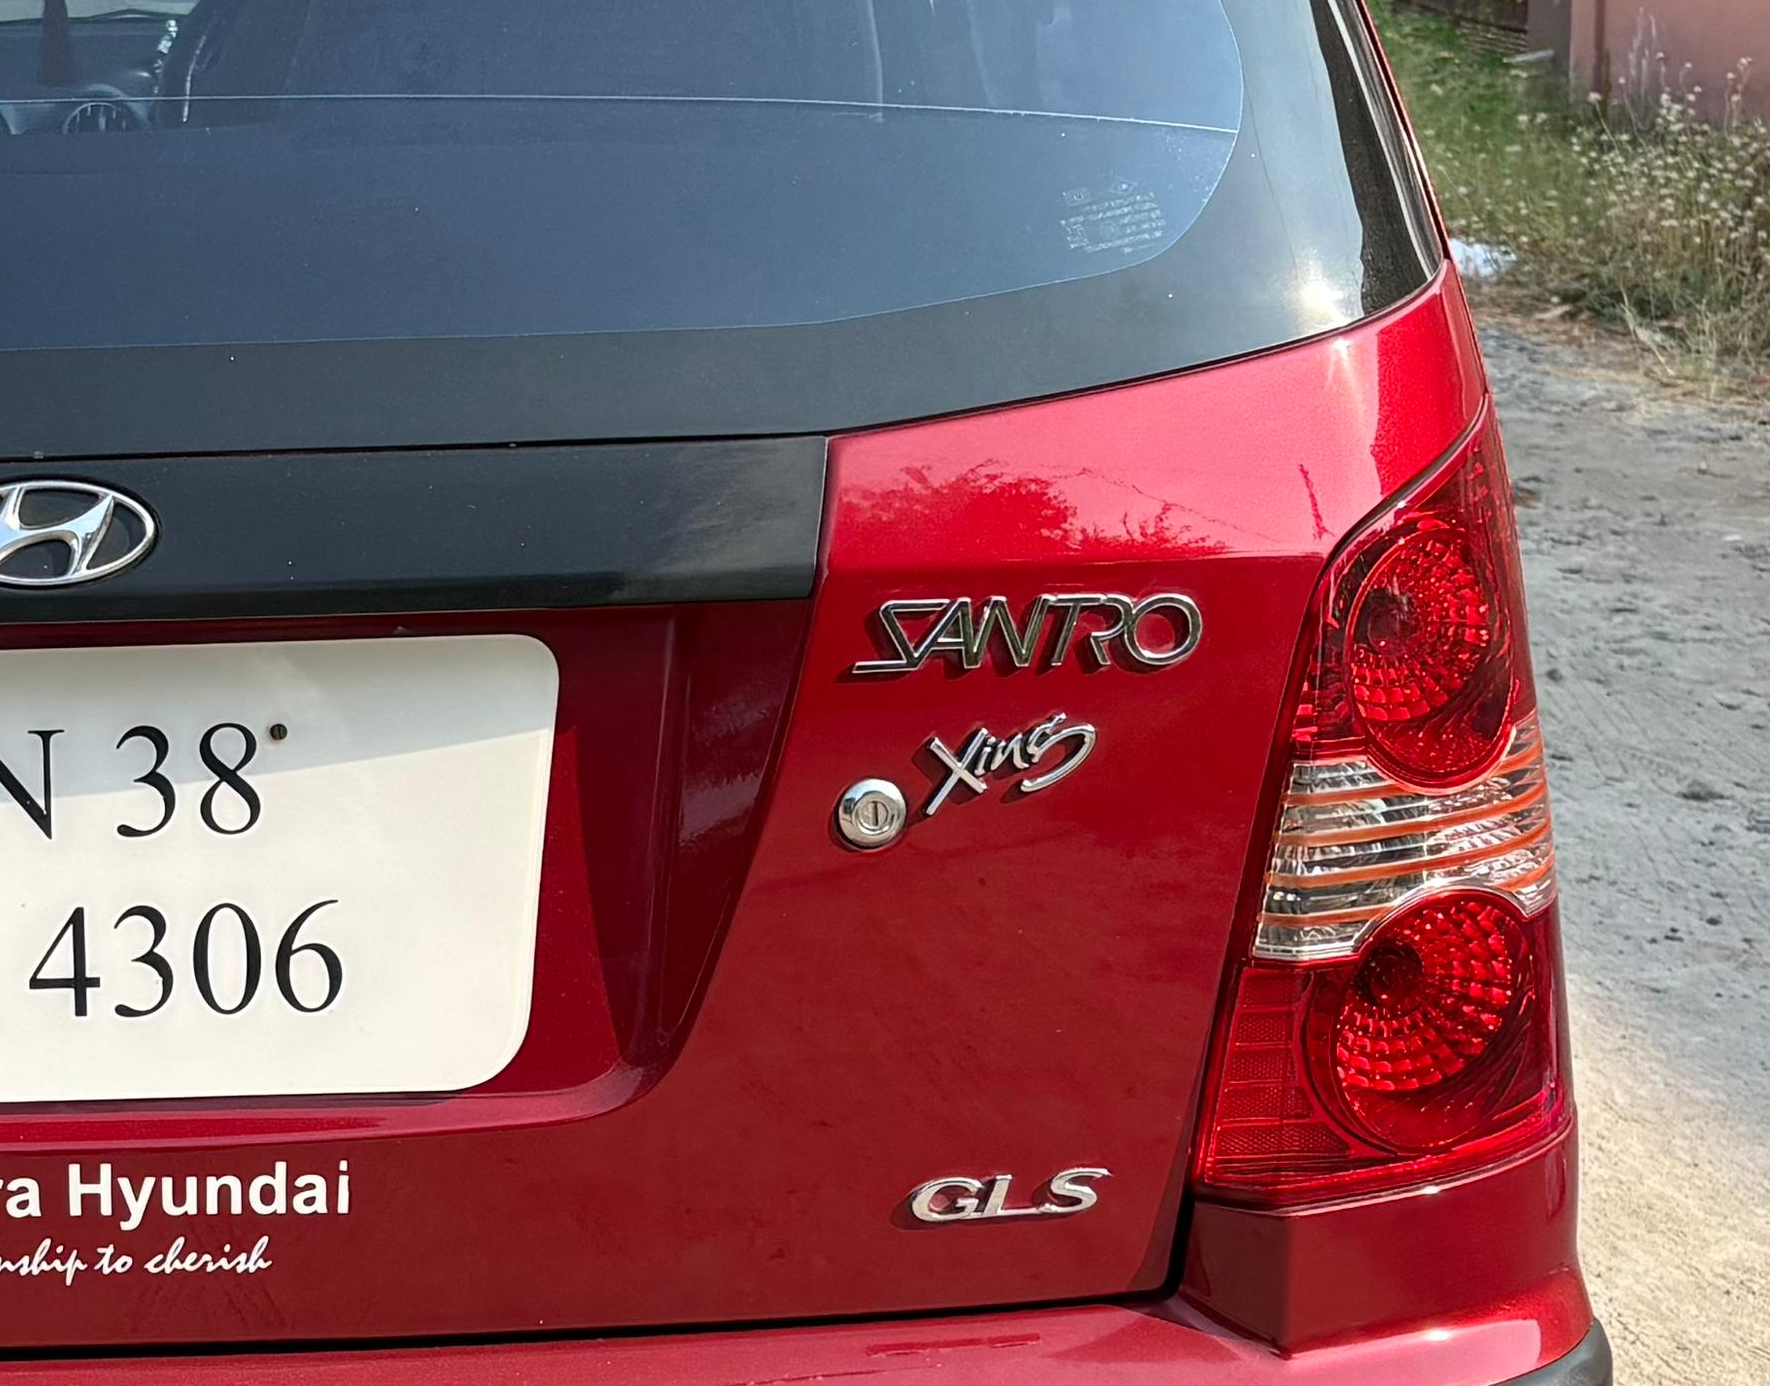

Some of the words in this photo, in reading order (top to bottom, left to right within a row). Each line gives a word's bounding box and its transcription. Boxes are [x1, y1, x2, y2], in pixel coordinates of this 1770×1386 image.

[852, 592, 1203, 675] SANTRO
[116, 722, 261, 839] 38
[926, 712, 1097, 816] Xing
[29, 899, 344, 1019] 4306
[68, 1159, 350, 1231] Hyundai
[910, 1166, 1113, 1222] GLS
[93, 1243, 134, 1275] to
[143, 1235, 274, 1276] cherish
